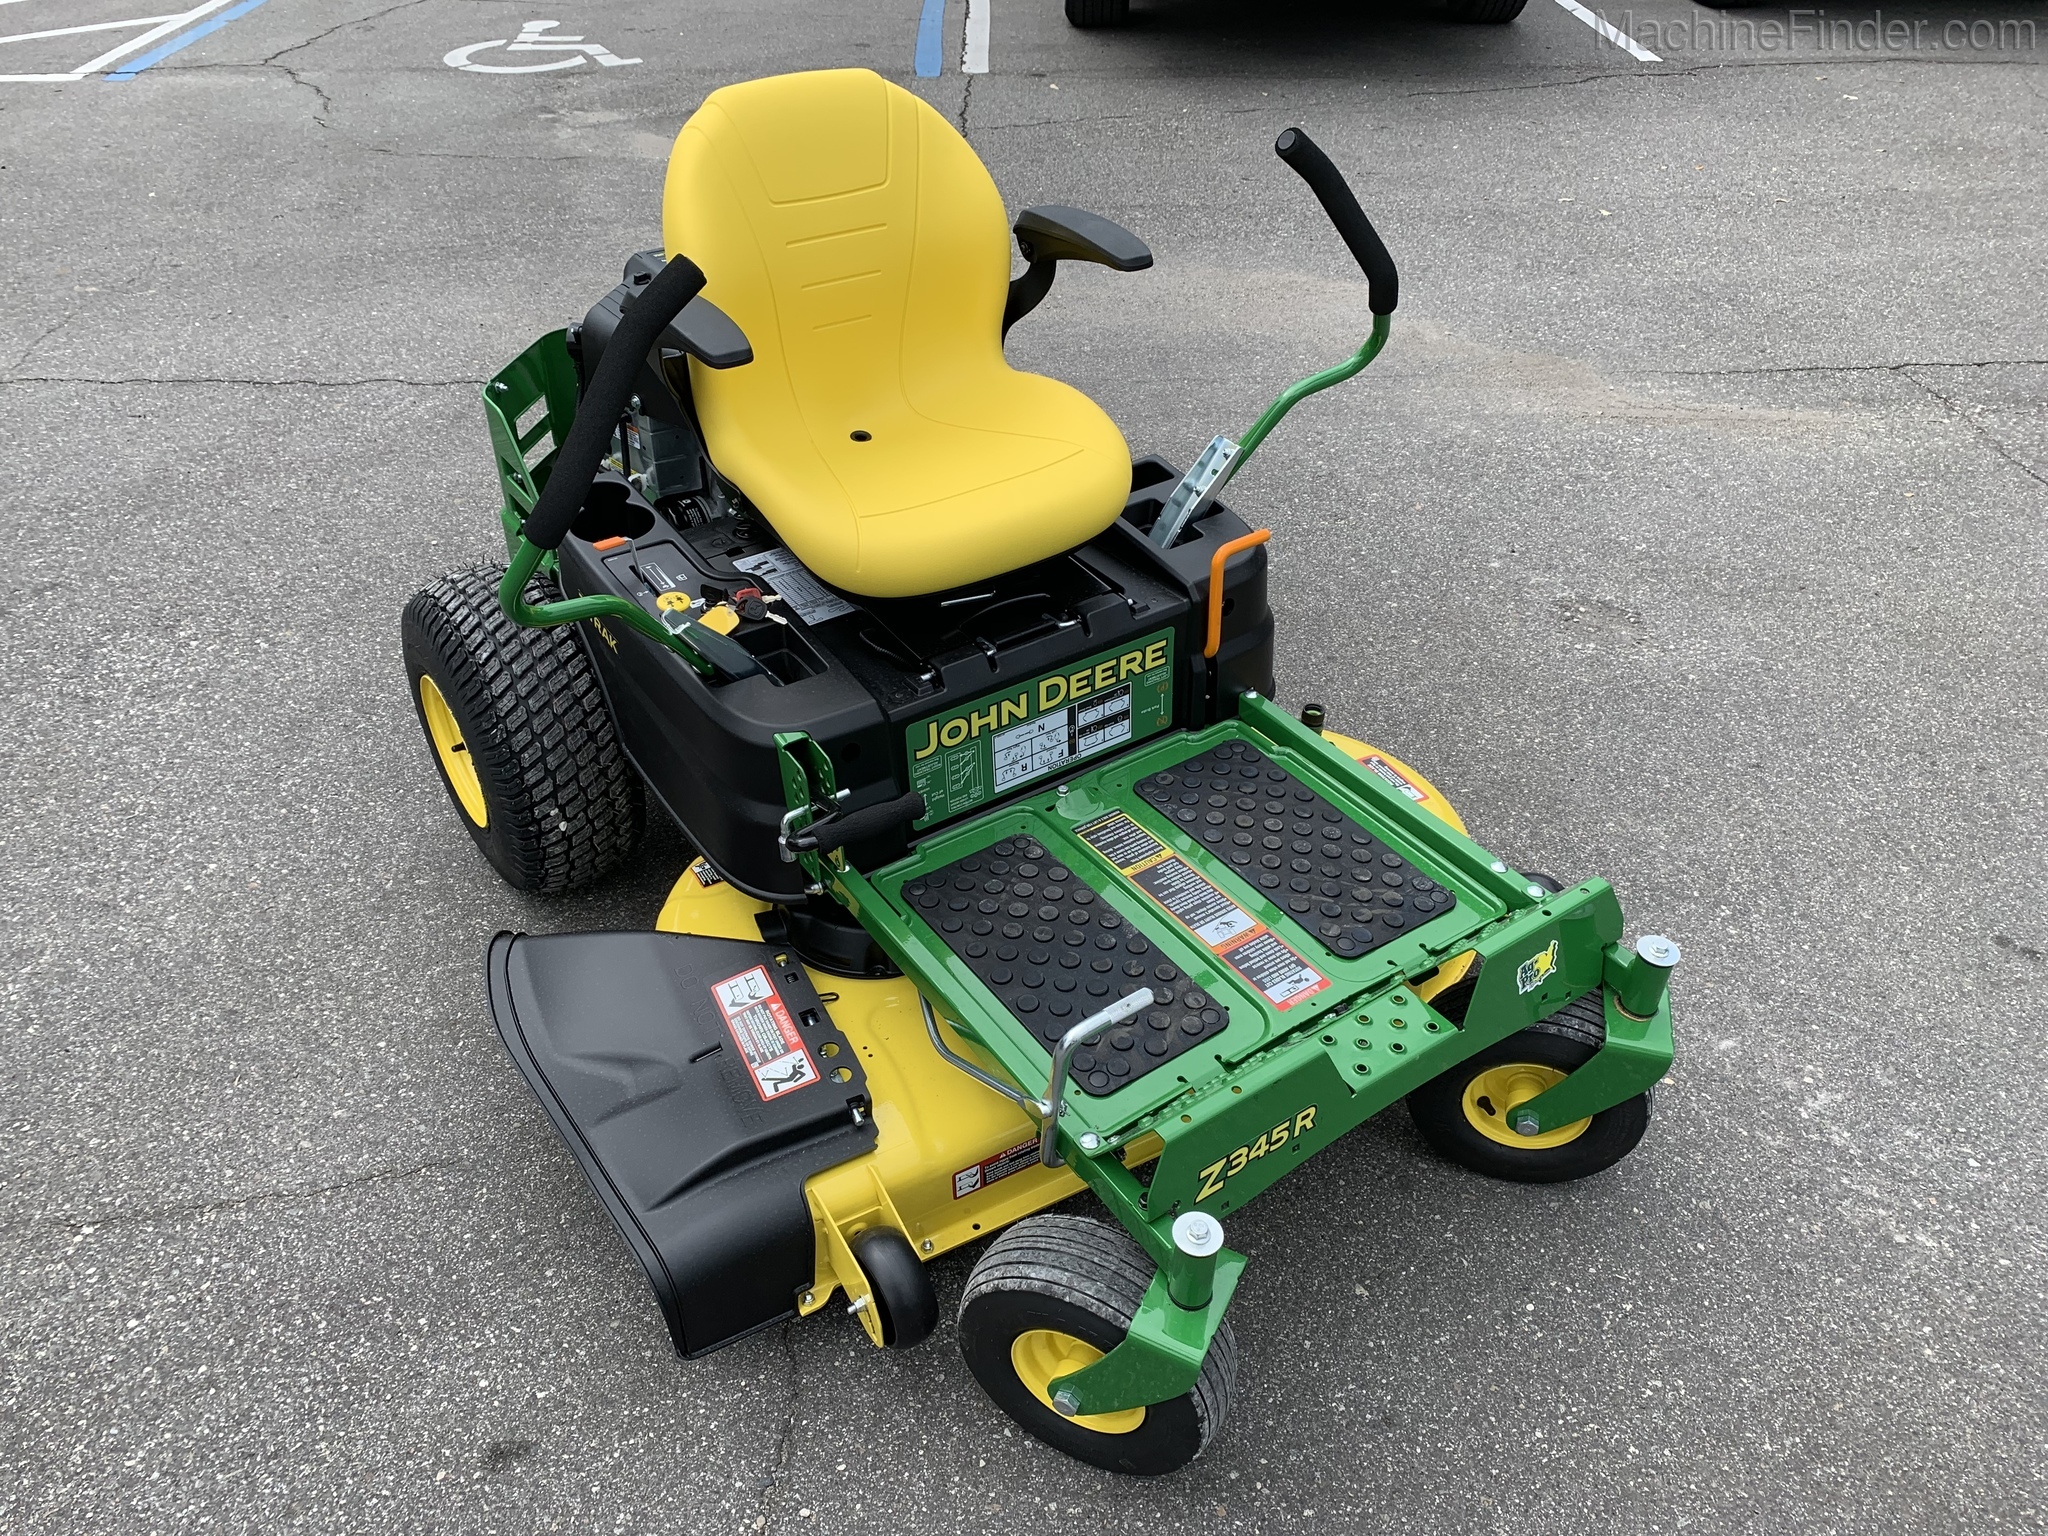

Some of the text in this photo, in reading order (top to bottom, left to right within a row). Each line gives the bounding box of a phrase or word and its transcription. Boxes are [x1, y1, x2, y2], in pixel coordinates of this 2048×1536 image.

[914, 693, 1029, 761] JOHN
[1038, 639, 1168, 712] DEERE
[1047, 753, 1082, 771] OPERATION
[1130, 856, 1157, 871] CAUTION
[1219, 932, 1251, 950] WARNING
[1521, 968, 1540, 989] Pro
[1287, 989, 1315, 1005] DANGER
[777, 1010, 799, 1044] DANGER
[1006, 1137, 1038, 1155] DANGER
[1193, 1103, 1318, 1205] Z345R
